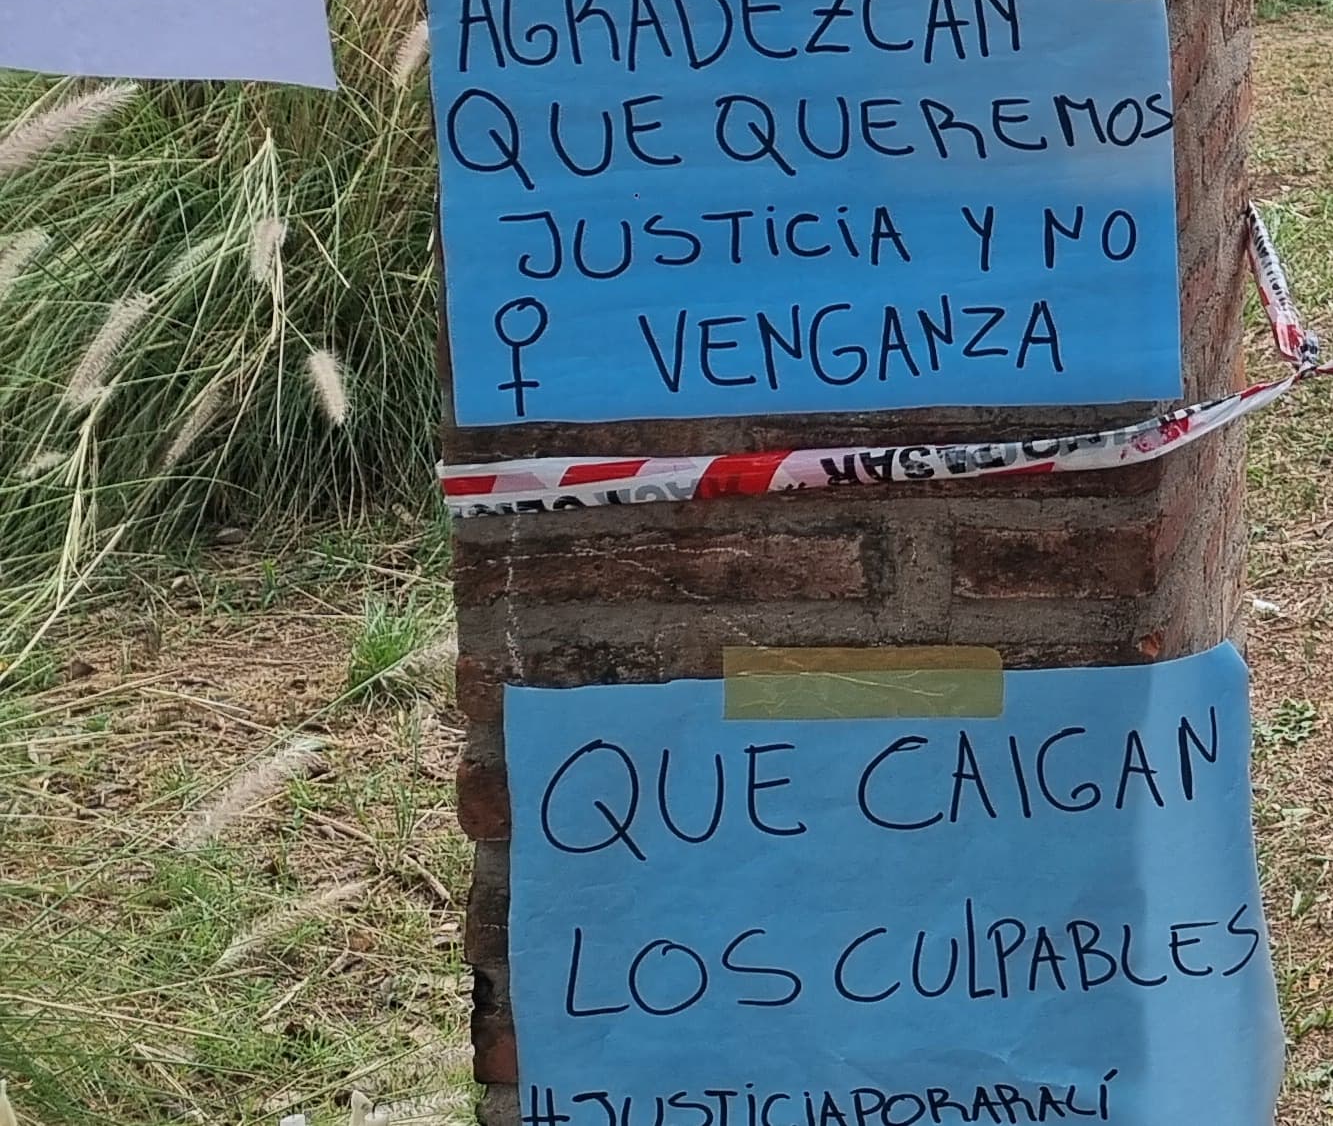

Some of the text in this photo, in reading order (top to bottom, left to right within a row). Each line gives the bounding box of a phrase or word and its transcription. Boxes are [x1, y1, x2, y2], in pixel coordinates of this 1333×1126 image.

[446, 87, 1175, 191] QUE QUEREMOS
[498, 205, 1138, 280] JUSTICIA Y NO
[636, 294, 1064, 394] VENGANZA
[540, 705, 1219, 862] QUE CAIGAN
[565, 897, 1260, 1018] LOS CULPABLES
[522, 1067, 1119, 1126] #JUSTICIAPORARALÍ
